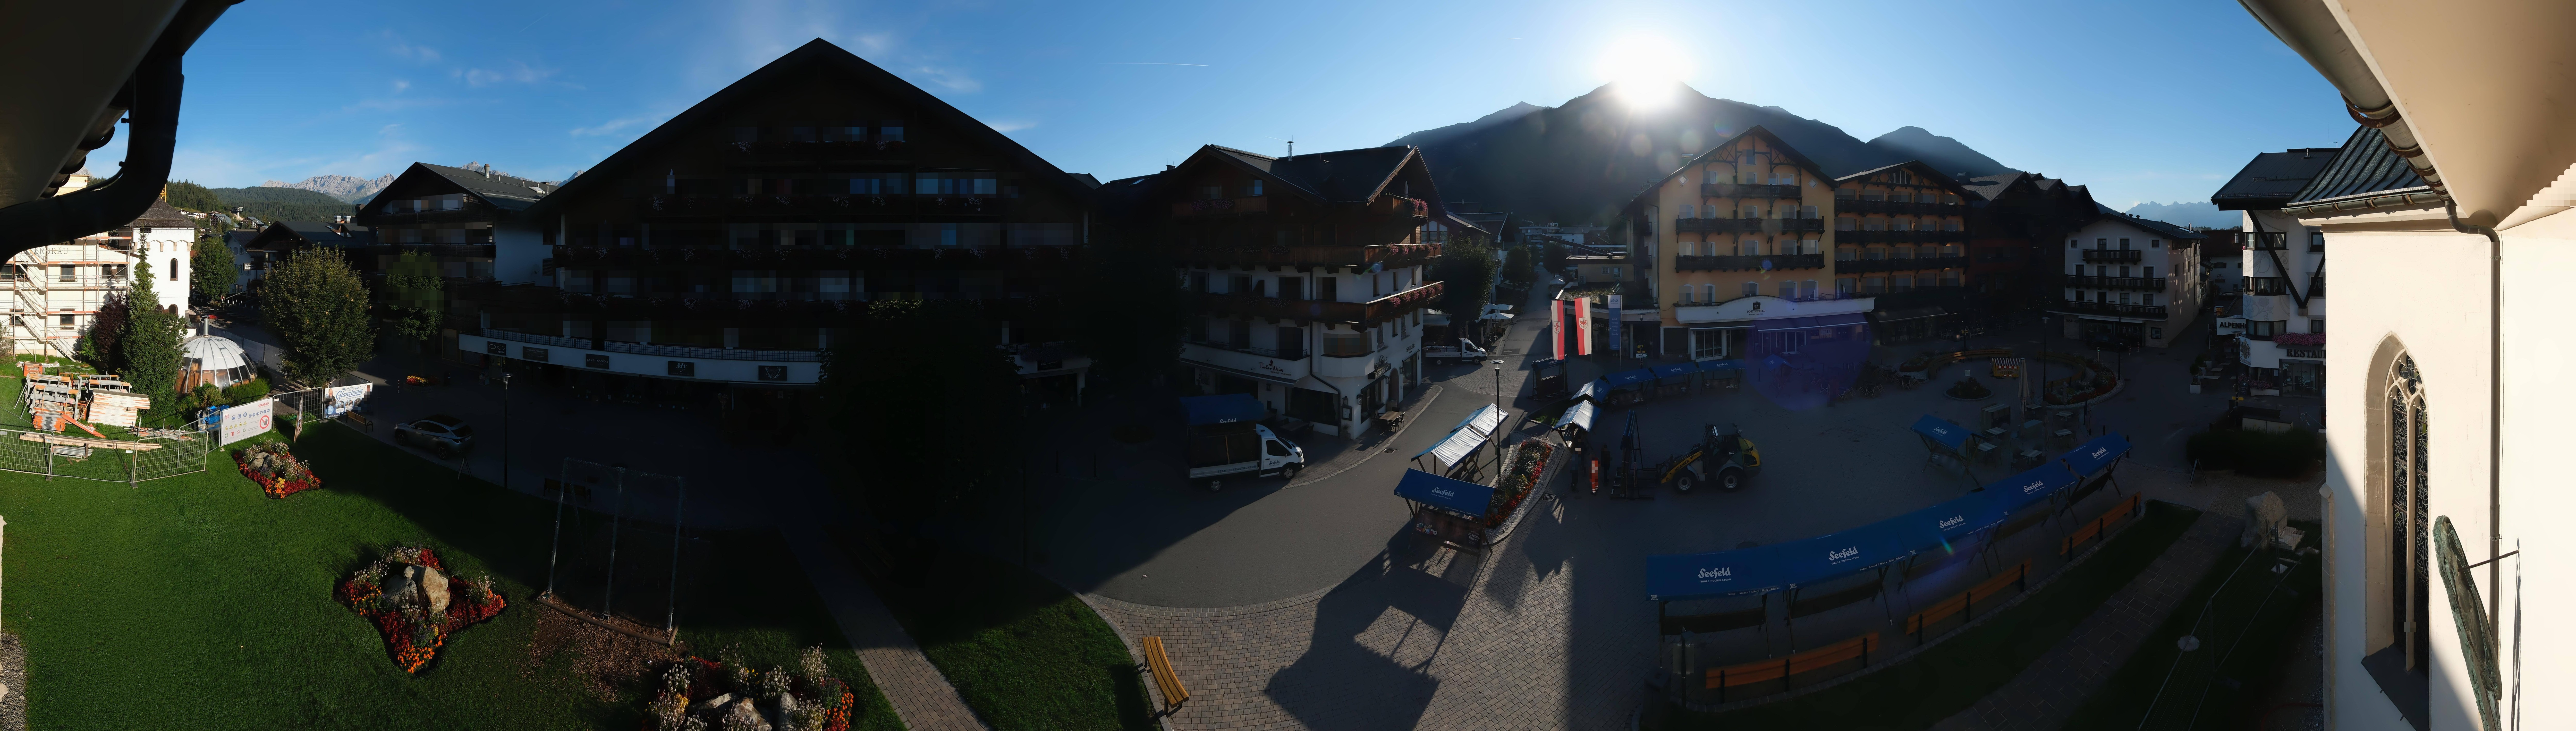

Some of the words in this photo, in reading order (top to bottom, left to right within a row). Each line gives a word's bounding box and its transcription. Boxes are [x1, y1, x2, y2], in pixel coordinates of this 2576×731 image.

[1406, 343, 1415, 352] SAILER
[1376, 365, 1389, 378] RESTAURANT
[336, 389, 363, 402] Glanzbuam
[2092, 447, 2107, 458] Seefeld
[1674, 460, 1690, 471] KRAMER
[1432, 487, 1455, 497] Seefeld
[2024, 480, 2043, 492] Seefeld
[1939, 515, 1964, 528] Seefeld
[1829, 546, 1858, 560] Seefeld
[1698, 567, 1731, 579] Seefeld
